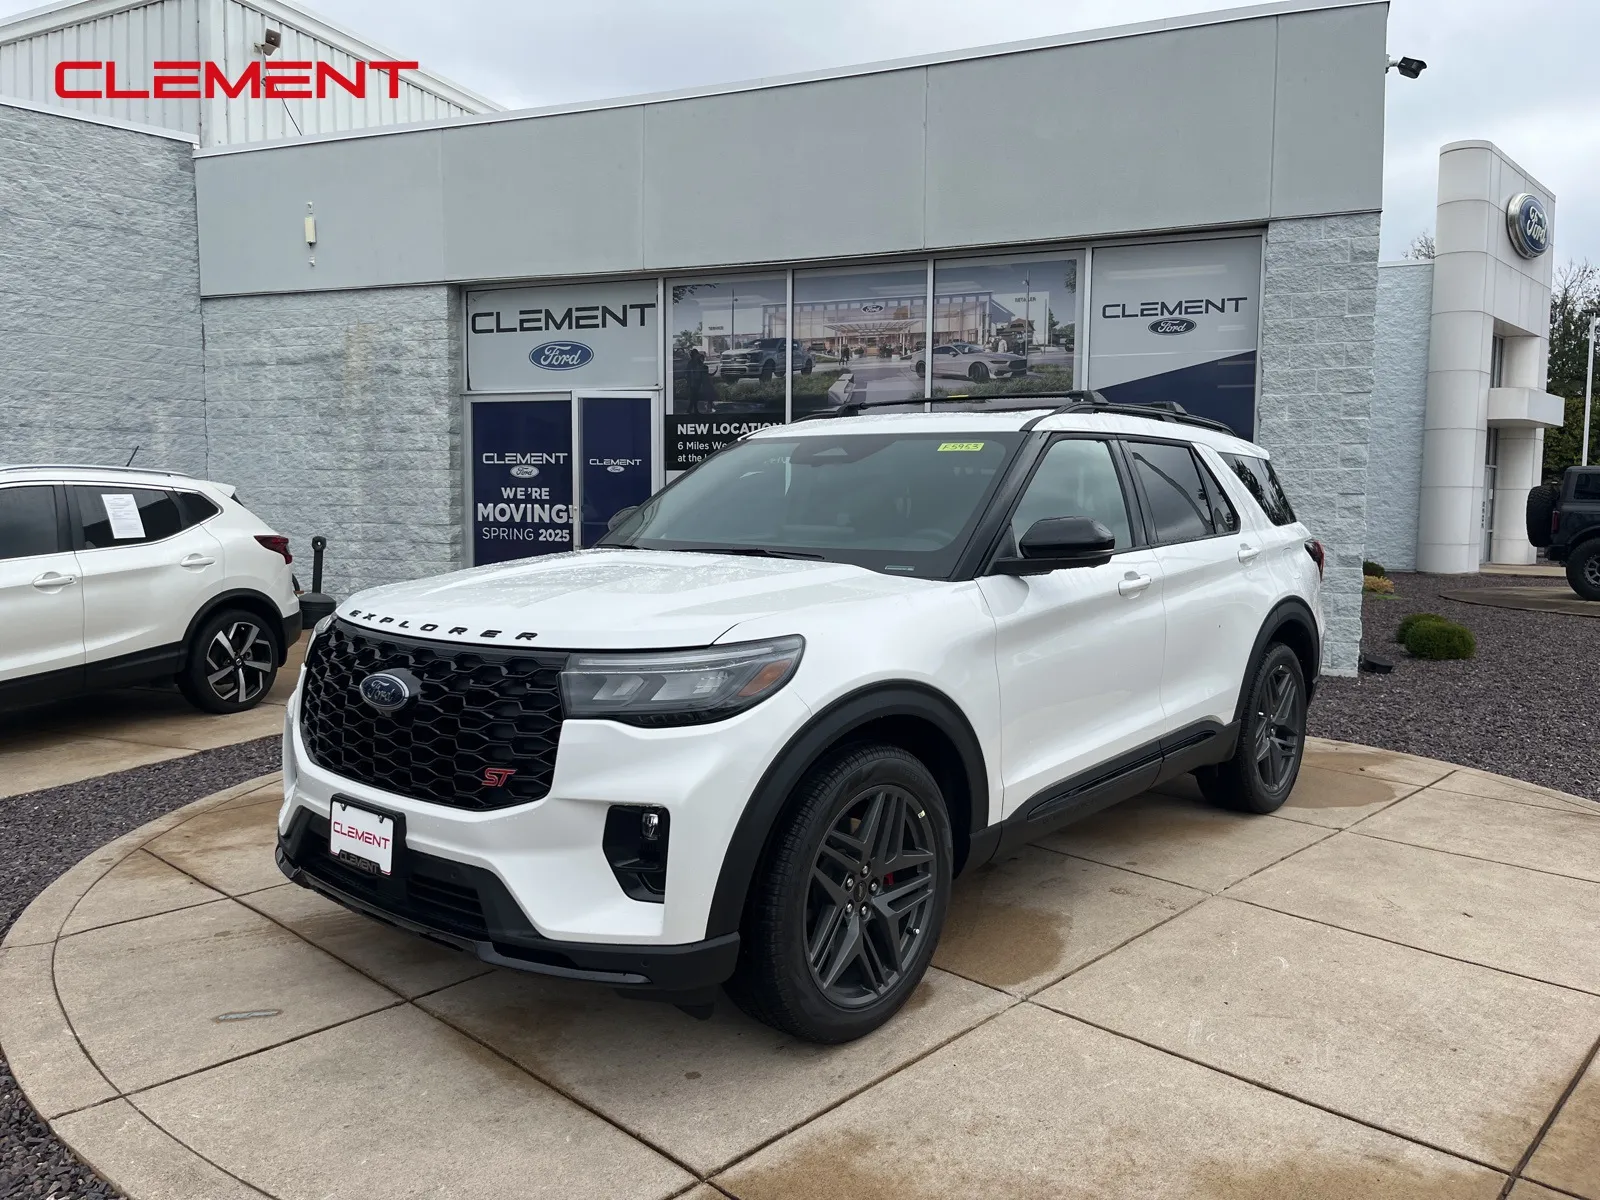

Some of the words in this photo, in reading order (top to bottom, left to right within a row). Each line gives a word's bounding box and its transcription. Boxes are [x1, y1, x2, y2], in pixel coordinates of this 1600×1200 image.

[1526, 206, 1547, 245] Ford
[1102, 297, 1248, 319] CLEMENT
[471, 303, 656, 334] CLEMENT
[1157, 319, 1188, 333] Ford
[539, 344, 583, 367] Ford
[677, 423, 709, 435] NEW
[713, 422, 783, 435] LOCATI
[677, 441, 684, 450] 6
[686, 441, 709, 450] Miles
[482, 452, 568, 465] CLEMENT
[589, 458, 642, 466] CLEMENT
[677, 454, 686, 462] at
[688, 453, 702, 462] the
[501, 487, 550, 499] WE'RE
[477, 503, 574, 523] MOVING!
[482, 527, 534, 541] SPRING
[538, 529, 570, 542] 2025
[349, 609, 538, 641] EXPLORER
[366, 679, 396, 703] Ford
[481, 767, 518, 787] ST
[333, 821, 391, 850] CLEMENT
[339, 850, 379, 874] CLEMENT
